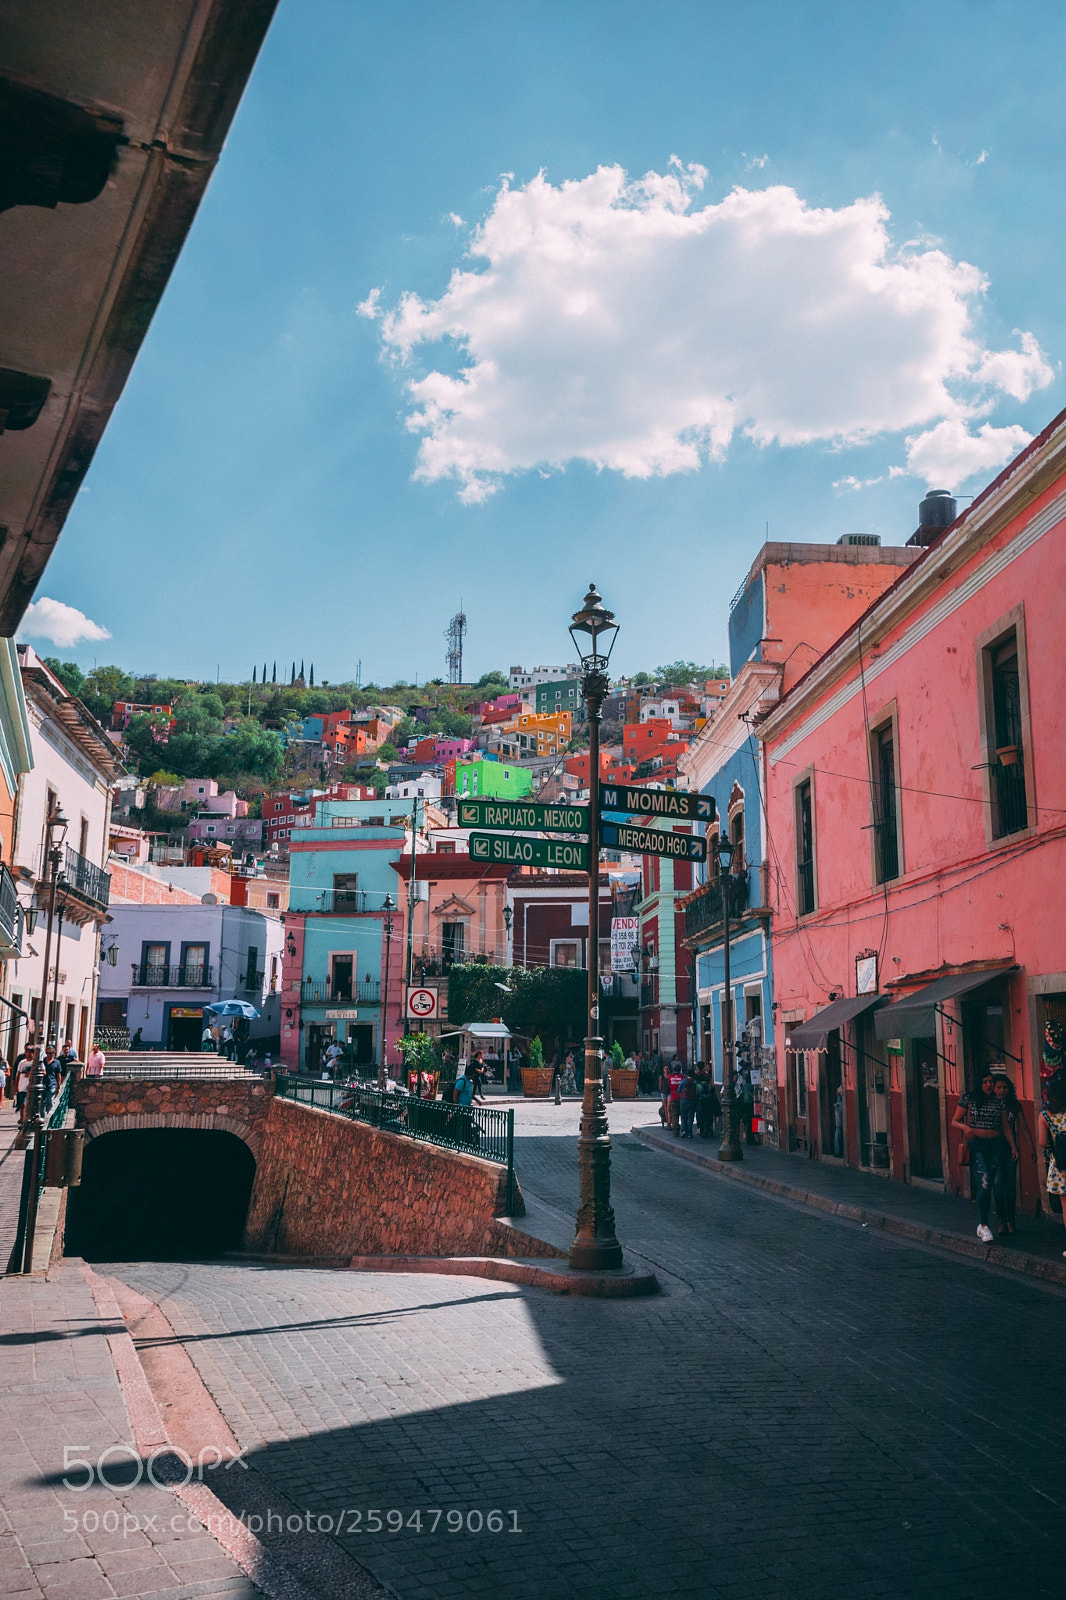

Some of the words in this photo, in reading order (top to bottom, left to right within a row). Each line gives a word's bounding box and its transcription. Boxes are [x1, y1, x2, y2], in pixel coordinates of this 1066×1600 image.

[604, 791, 617, 805] M
[627, 791, 689, 815] MOMIAS
[485, 807, 536, 827] IRAPUATO
[544, 809, 582, 829] MEXICO
[493, 842, 533, 861] SILAO
[547, 845, 582, 865] LEON
[618, 829, 665, 852] MERCADO
[666, 837, 689, 856] HGO.
[420, 993, 426, 1001] E
